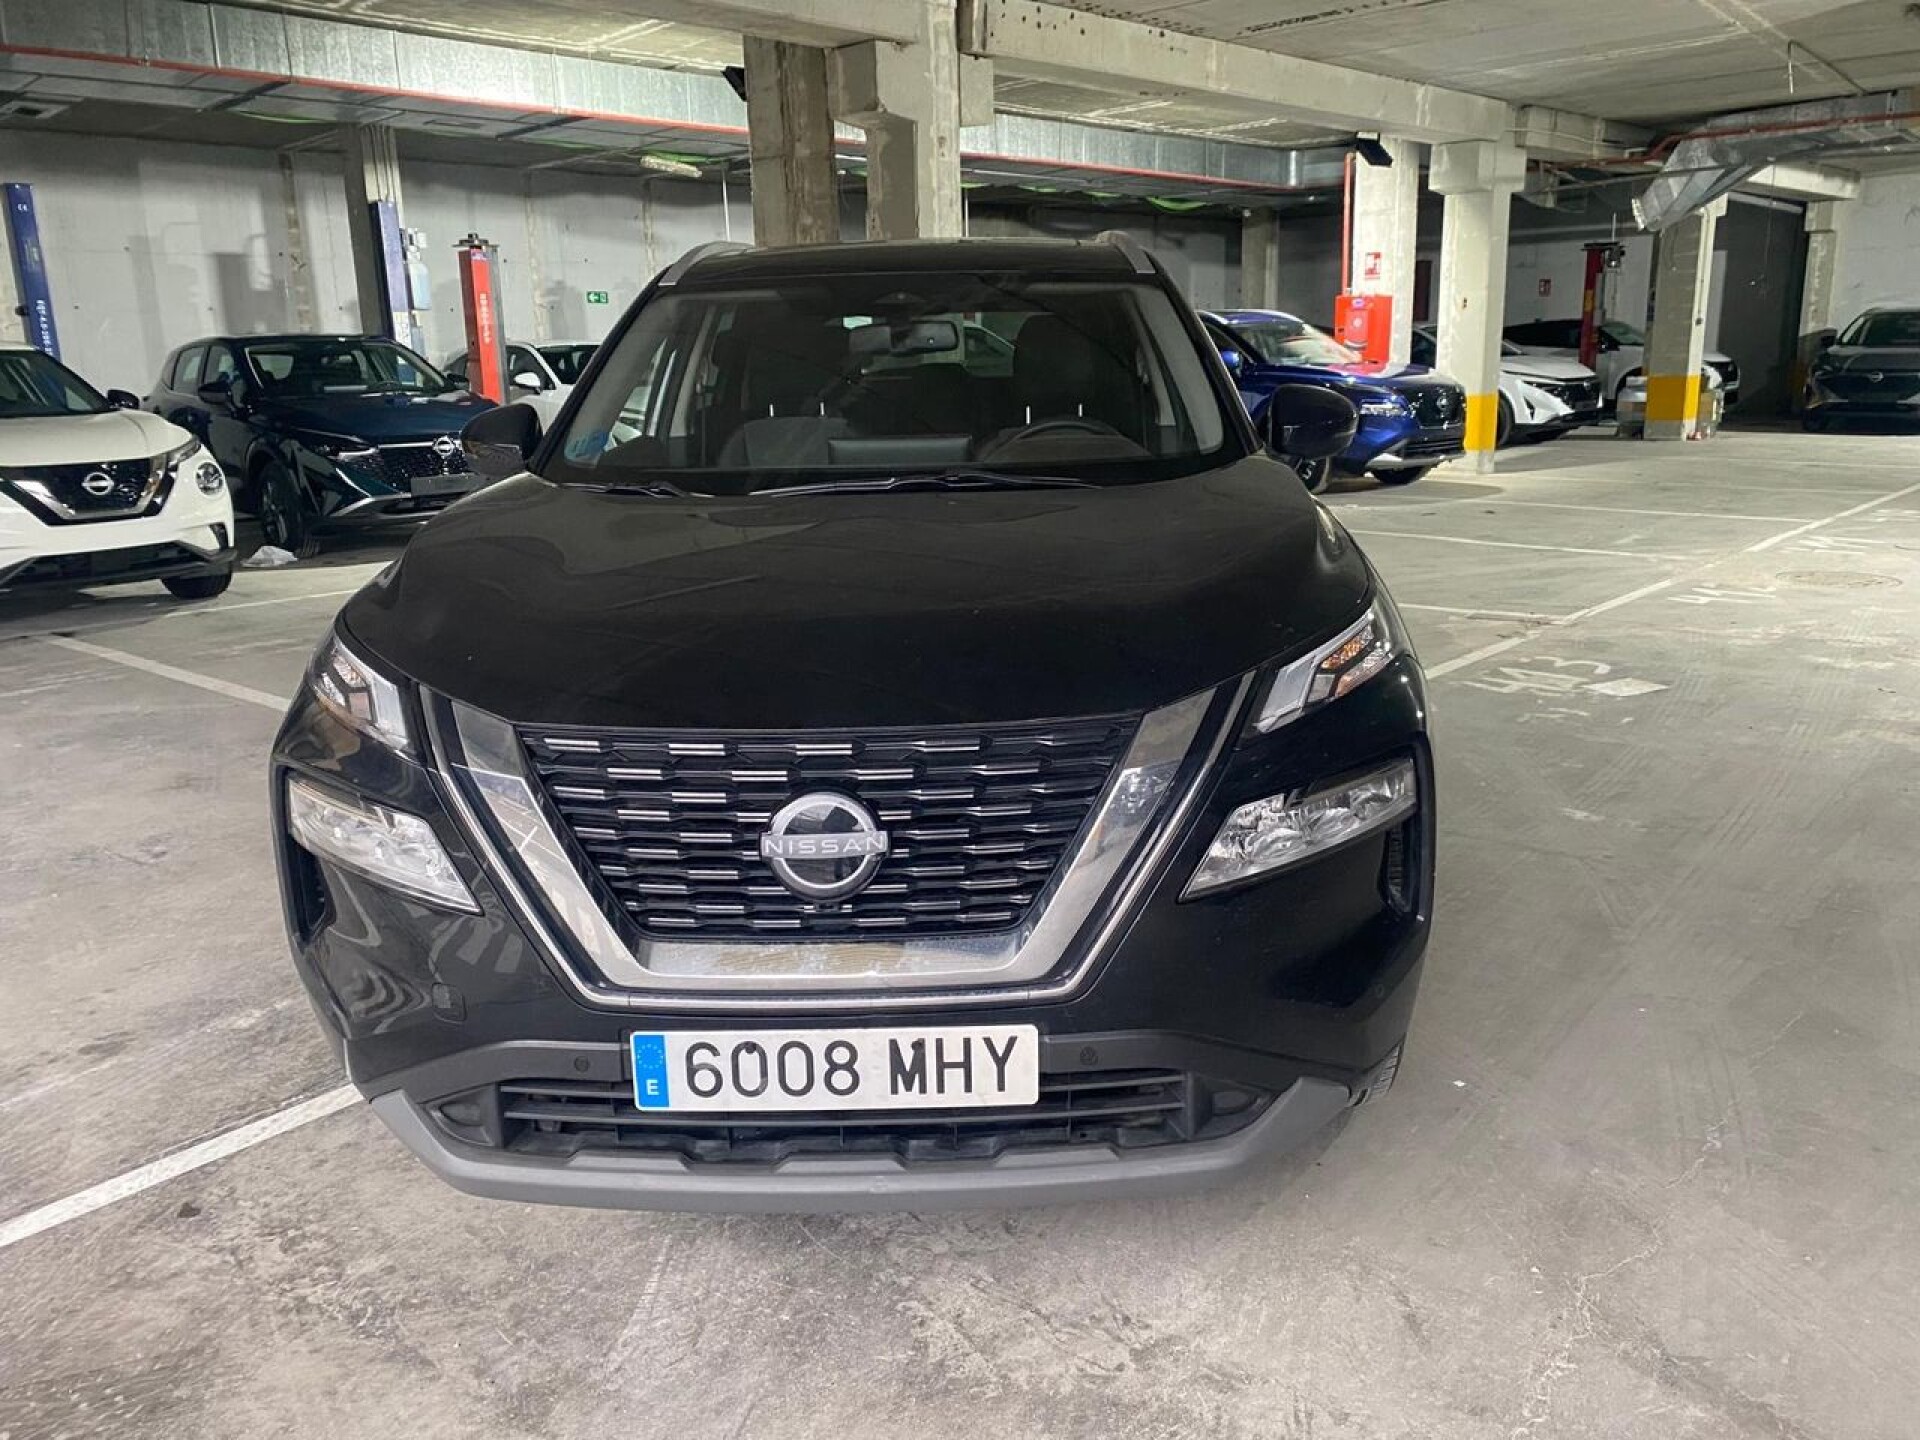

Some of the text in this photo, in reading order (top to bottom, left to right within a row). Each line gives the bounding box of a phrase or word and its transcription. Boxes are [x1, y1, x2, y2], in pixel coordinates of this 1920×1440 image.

[764, 835, 884, 855] NISSAN
[685, 1035, 1018, 1098] 6008 MHY
[645, 1079, 660, 1096] E
